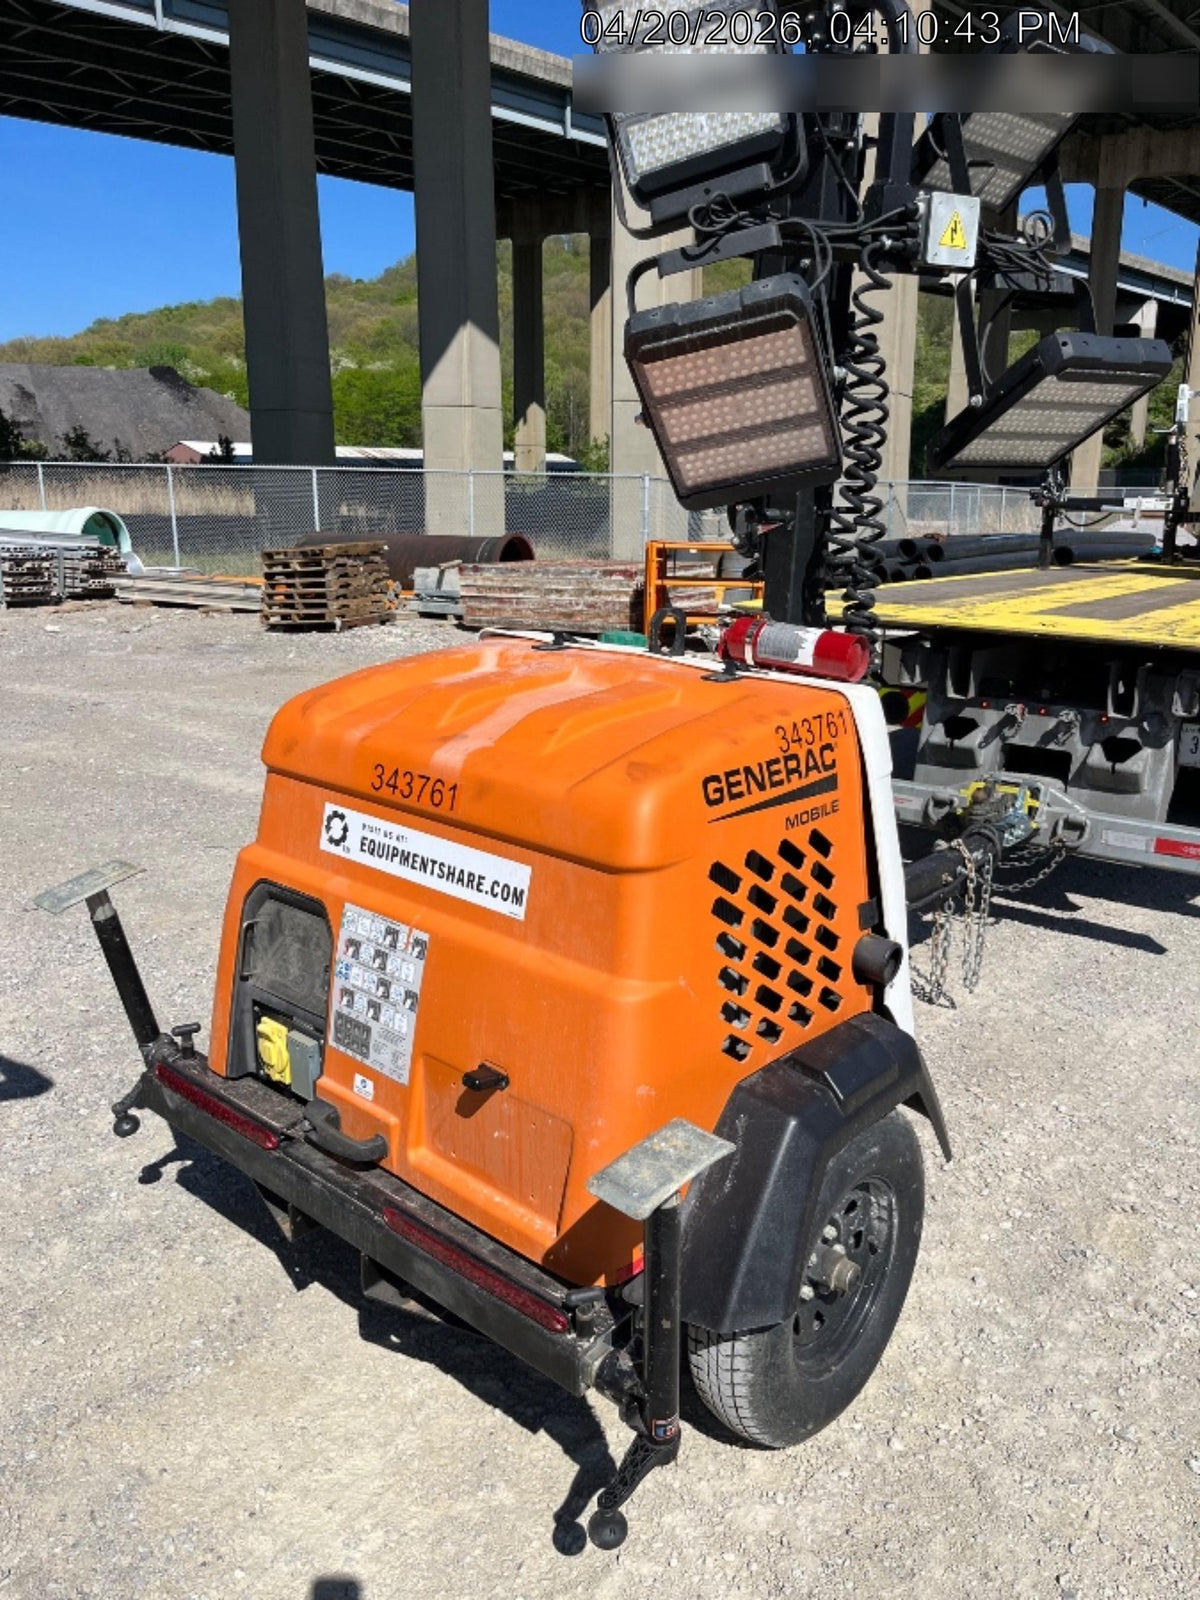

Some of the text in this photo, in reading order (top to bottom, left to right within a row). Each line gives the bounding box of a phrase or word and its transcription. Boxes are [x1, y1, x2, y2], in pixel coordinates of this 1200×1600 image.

[775, 711, 848, 753] 343761
[371, 764, 458, 811] 343761
[702, 742, 837, 808] GENERAC
[785, 800, 840, 830] MOBILE
[360, 836, 525, 907] EQUIPMENTSHARE.COM
